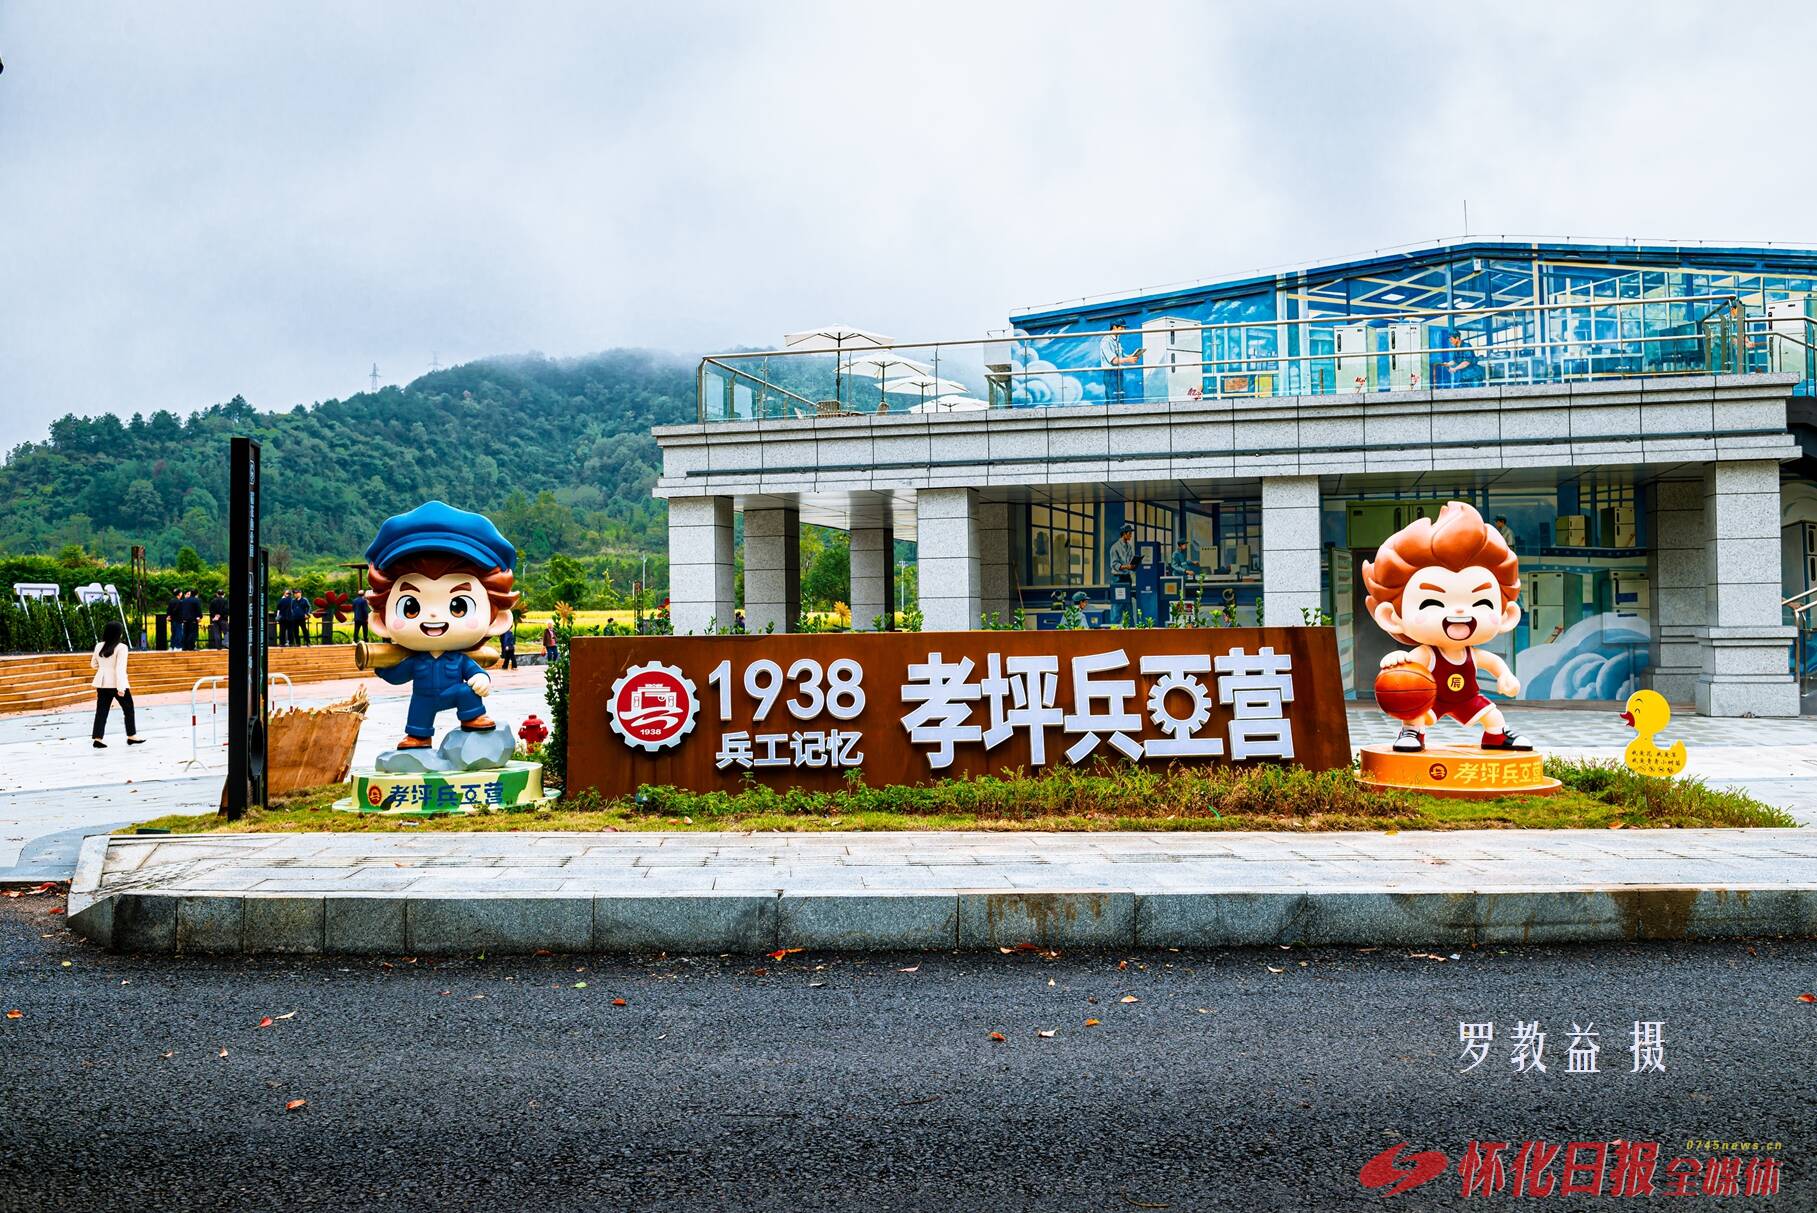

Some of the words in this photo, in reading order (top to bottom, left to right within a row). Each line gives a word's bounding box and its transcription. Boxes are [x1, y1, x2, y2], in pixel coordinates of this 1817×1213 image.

[708, 659, 866, 721] 1938
[900, 647, 1296, 769] 孝坪兵工营
[715, 730, 864, 769] 兵工记忆
